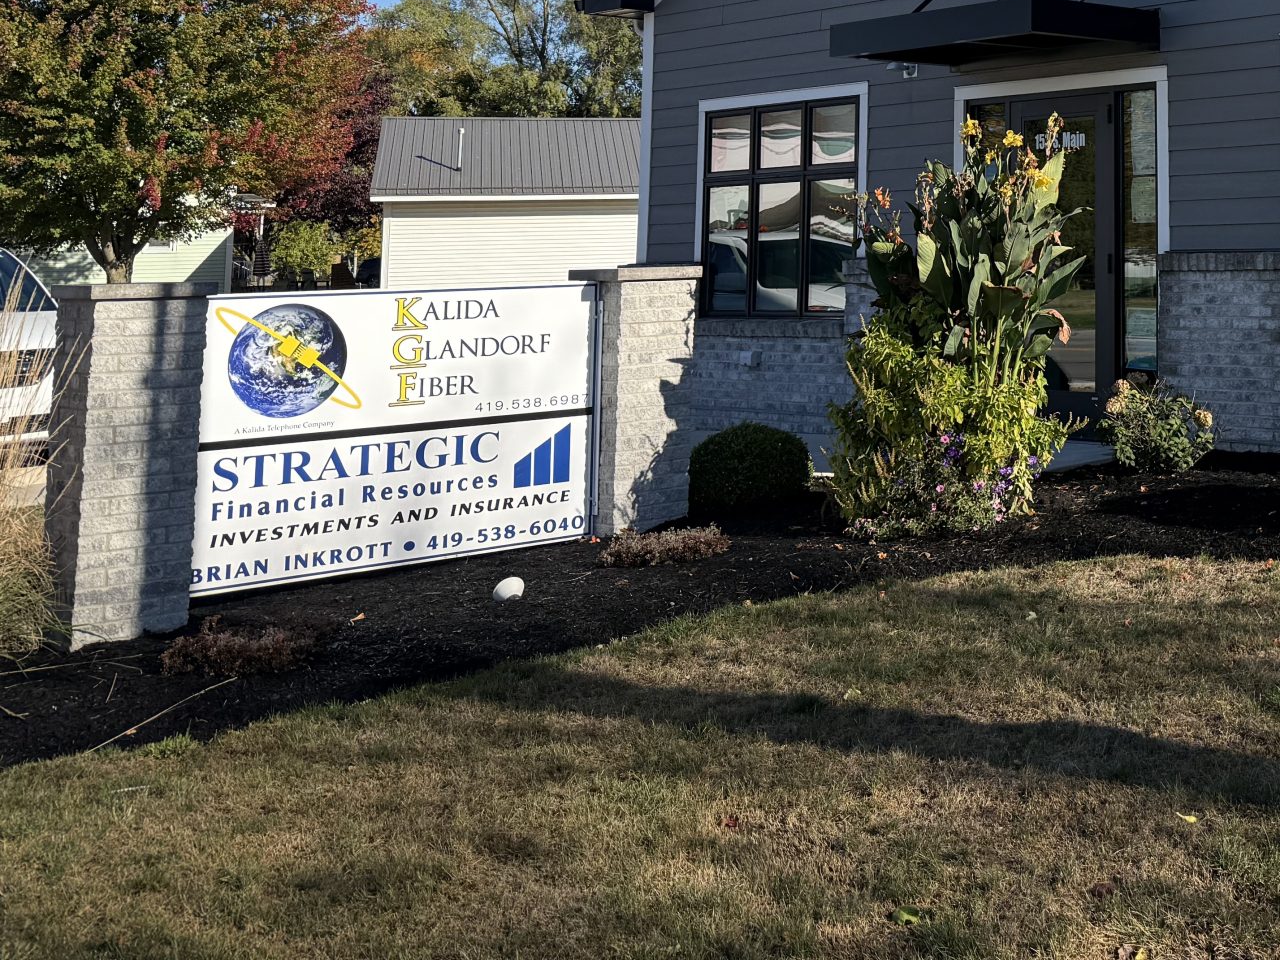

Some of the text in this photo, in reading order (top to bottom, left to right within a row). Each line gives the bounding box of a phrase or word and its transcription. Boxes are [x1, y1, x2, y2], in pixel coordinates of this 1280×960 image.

[1035, 133, 1050, 150] 15
[1062, 131, 1086, 148] Main
[394, 297, 500, 329] KALIDA
[391, 334, 551, 365] GLANDORF
[396, 371, 479, 403] FIBER
[475, 393, 589, 413] 419.538.6987
[234, 420, 335, 435] A Kalida Telephone Company
[212, 430, 500, 494] STRATEGIC
[211, 473, 498, 522] Financial Resources
[209, 490, 571, 549] INVESTMENTS AND INSURANCE
[191, 514, 585, 585] BRIAN INKROTT 419-538-6040
